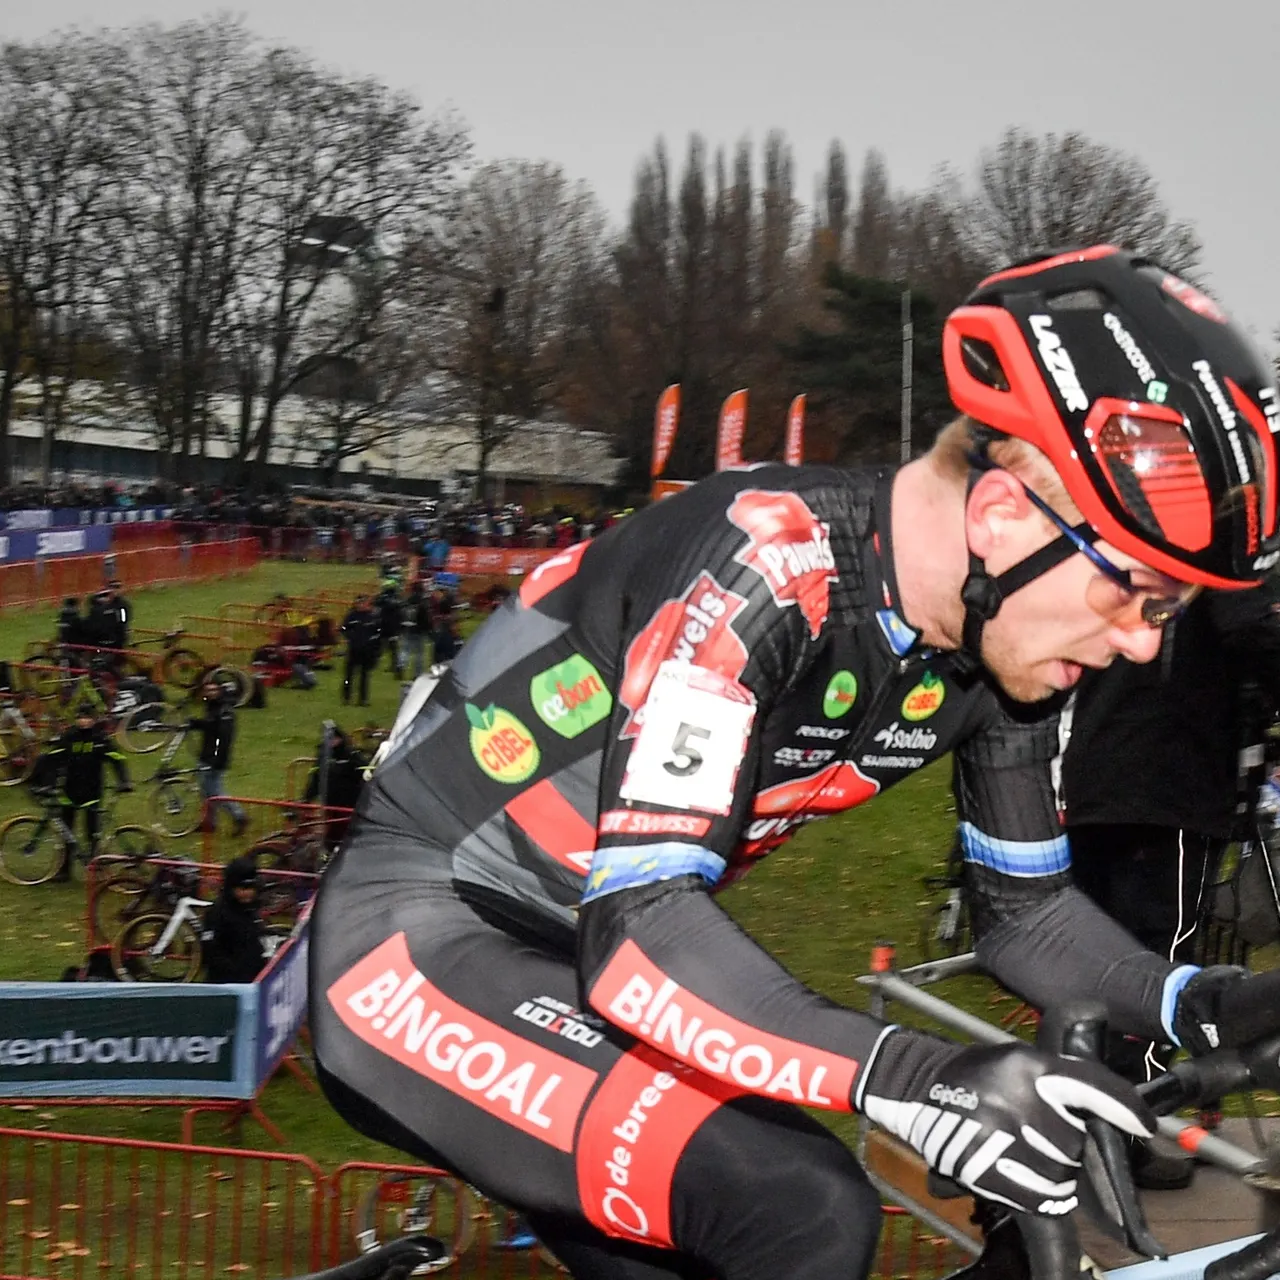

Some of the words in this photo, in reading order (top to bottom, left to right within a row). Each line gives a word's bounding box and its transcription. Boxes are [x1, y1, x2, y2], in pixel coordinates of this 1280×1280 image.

[1028, 313, 1089, 414] LAZER
[481, 728, 532, 773] CIBEL
[663, 721, 712, 777] 5
[628, 814, 701, 833] SWISS
[612, 1070, 678, 1146] bree
[604, 1139, 634, 1185] de
